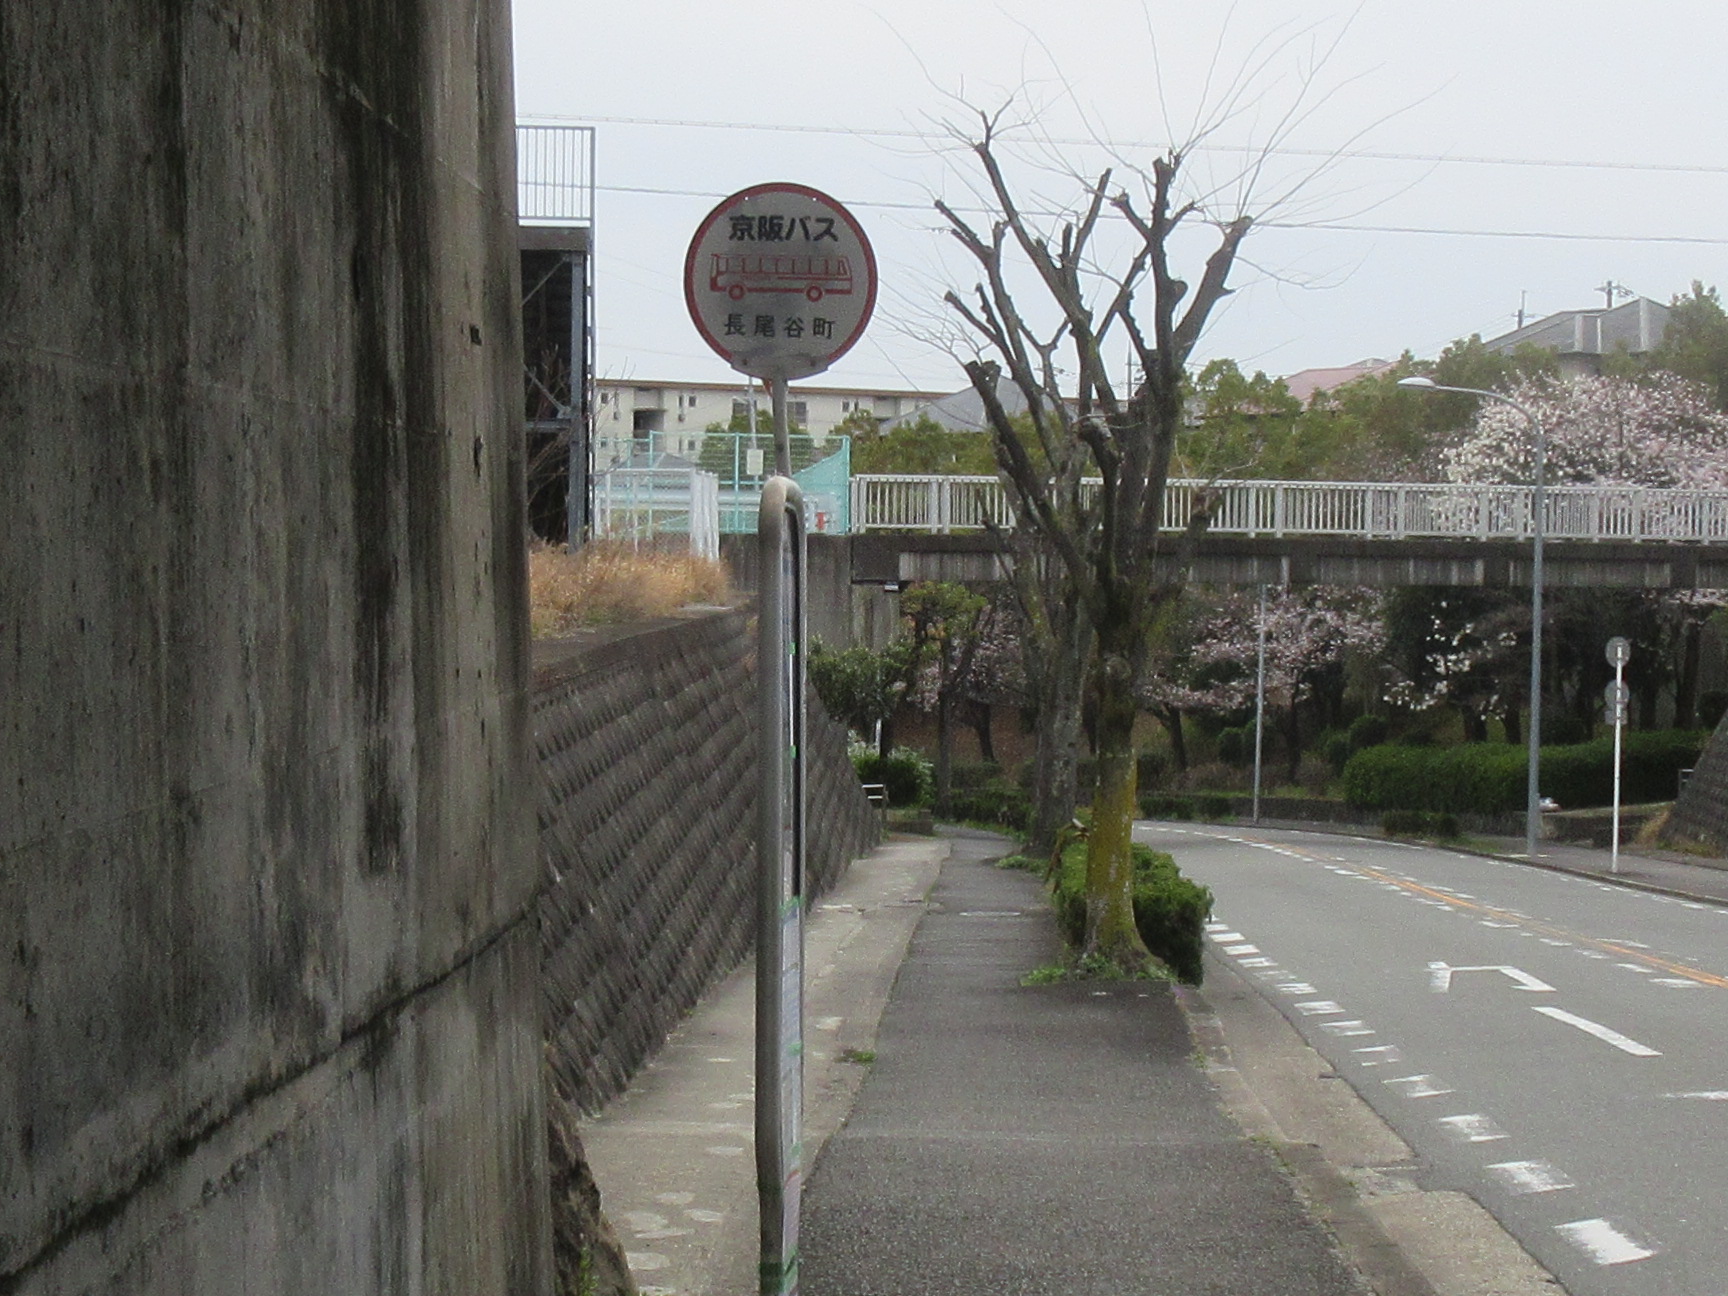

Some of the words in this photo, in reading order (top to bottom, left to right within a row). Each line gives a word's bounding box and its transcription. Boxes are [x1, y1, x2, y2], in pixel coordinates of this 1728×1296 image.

[728, 214, 839, 242] 京阪バス
[724, 313, 836, 340] 長尾谷町
